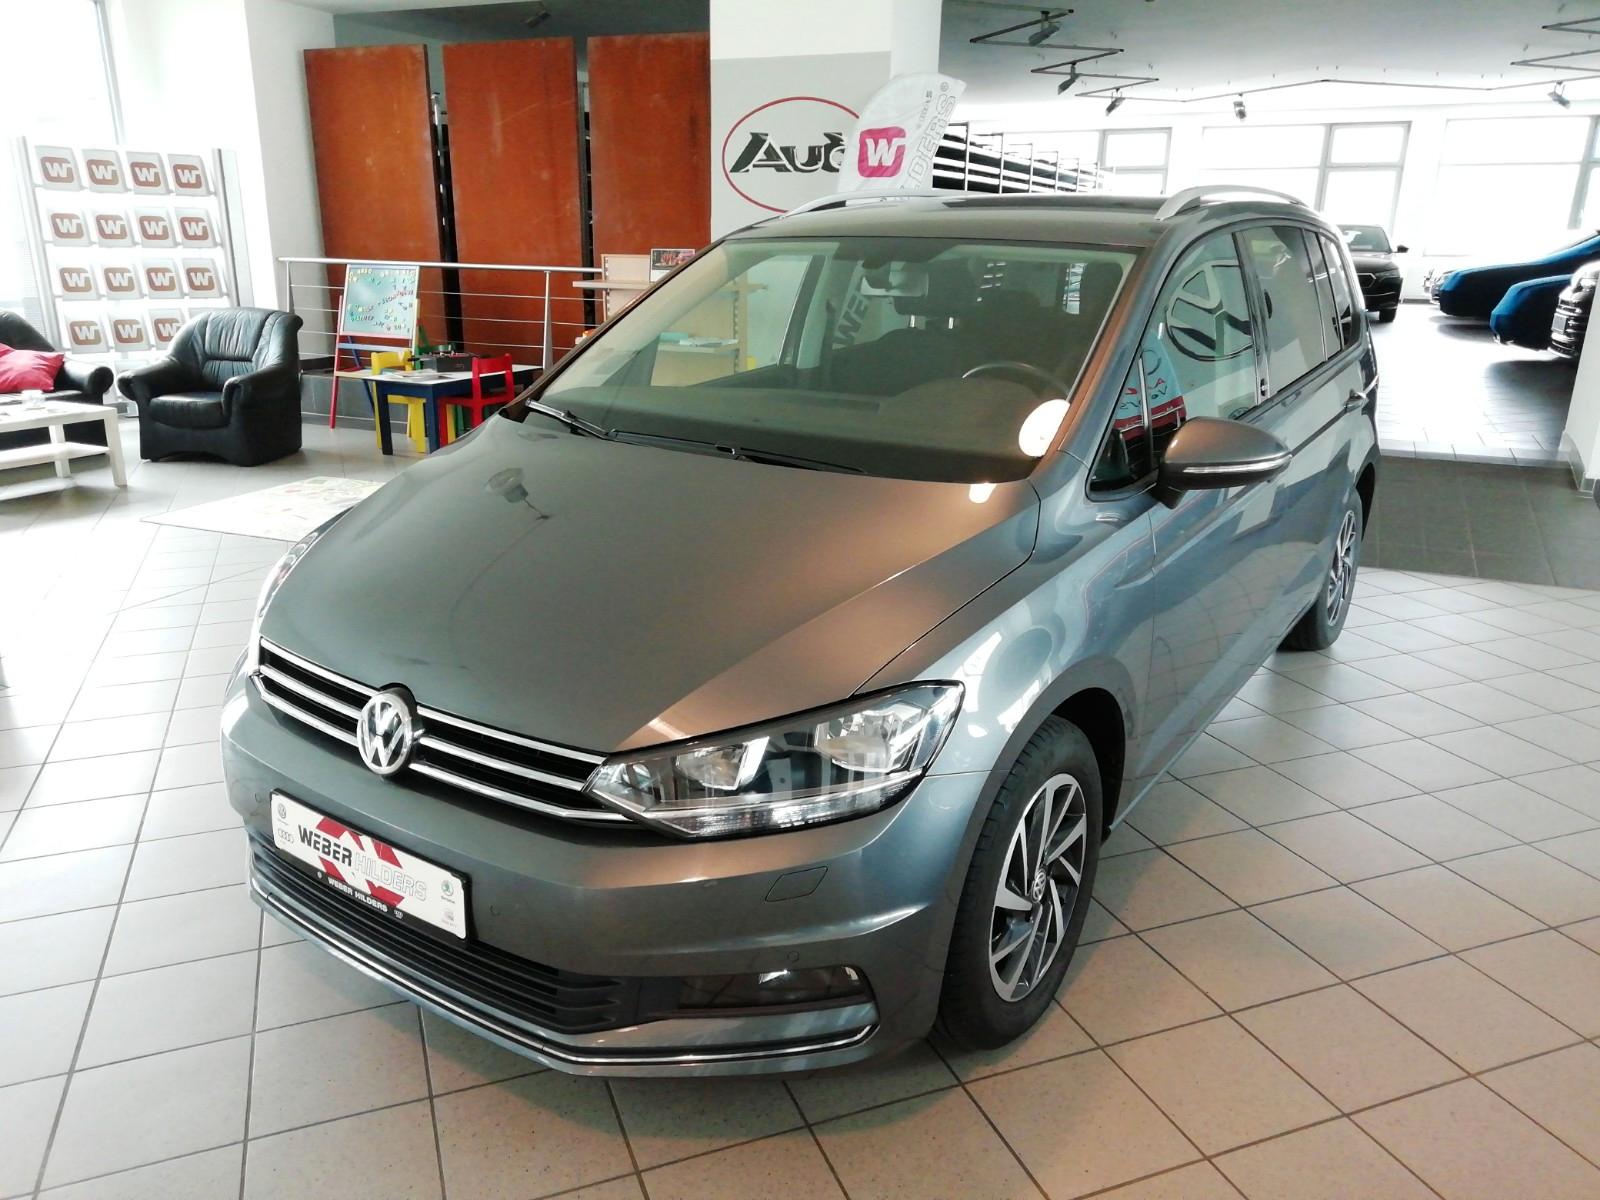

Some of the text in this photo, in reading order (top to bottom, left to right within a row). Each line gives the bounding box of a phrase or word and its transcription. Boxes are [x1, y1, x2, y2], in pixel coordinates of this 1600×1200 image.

[729, 132, 846, 173] Aud
[298, 824, 427, 901] WEBER HILDERS
[328, 877, 388, 913] WEBER HILDERS
